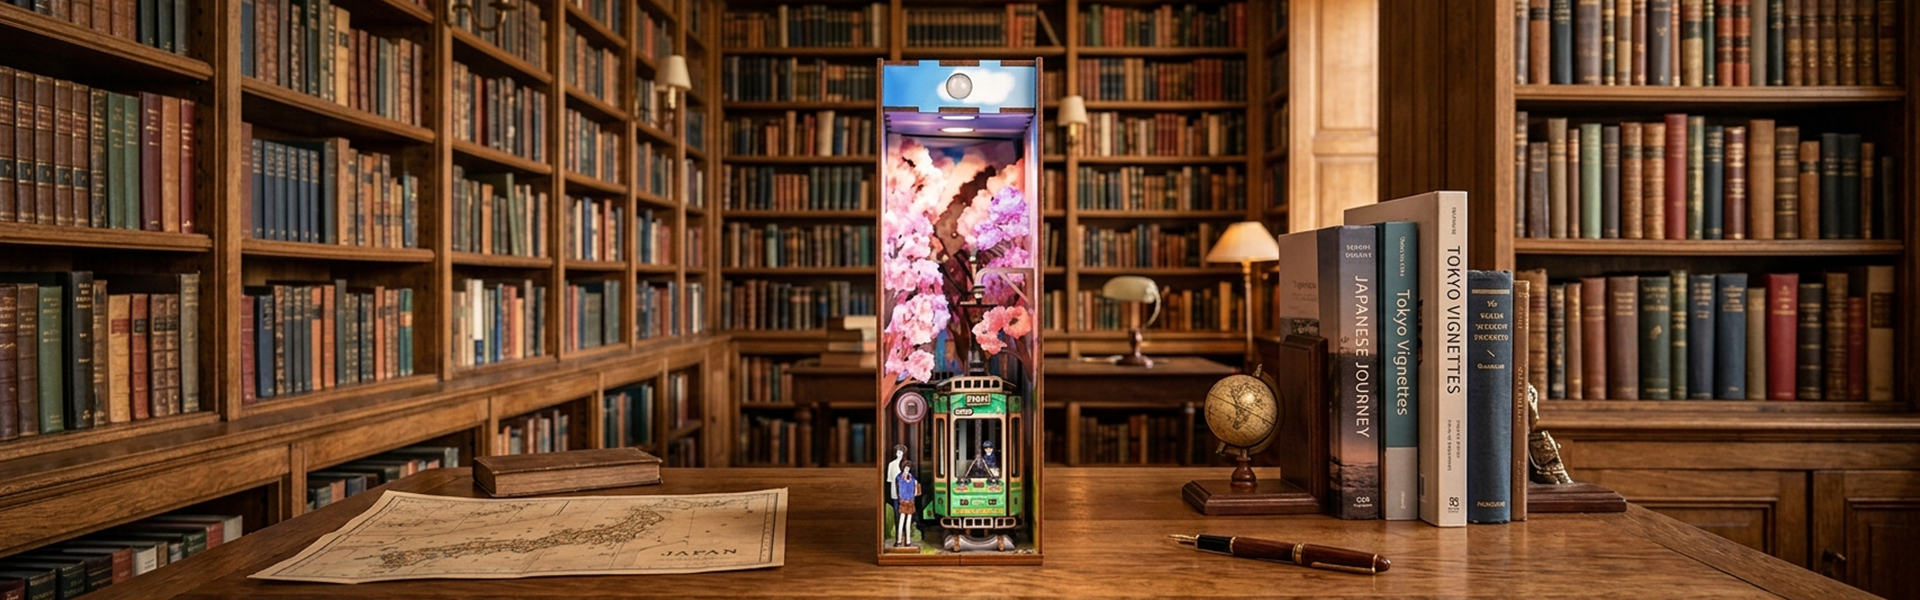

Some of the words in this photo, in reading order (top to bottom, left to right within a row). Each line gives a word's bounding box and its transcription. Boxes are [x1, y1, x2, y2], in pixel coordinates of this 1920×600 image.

[1447, 245, 1461, 301] TOKYO
[1354, 275, 1369, 357] JAPANESE
[1393, 290, 1410, 335] Tokyo
[1447, 305, 1461, 395] VIGNETTES
[1355, 362, 1370, 438] JOURNEY
[1393, 340, 1410, 416] Vignettes
[660, 548, 737, 556] JAPAN
